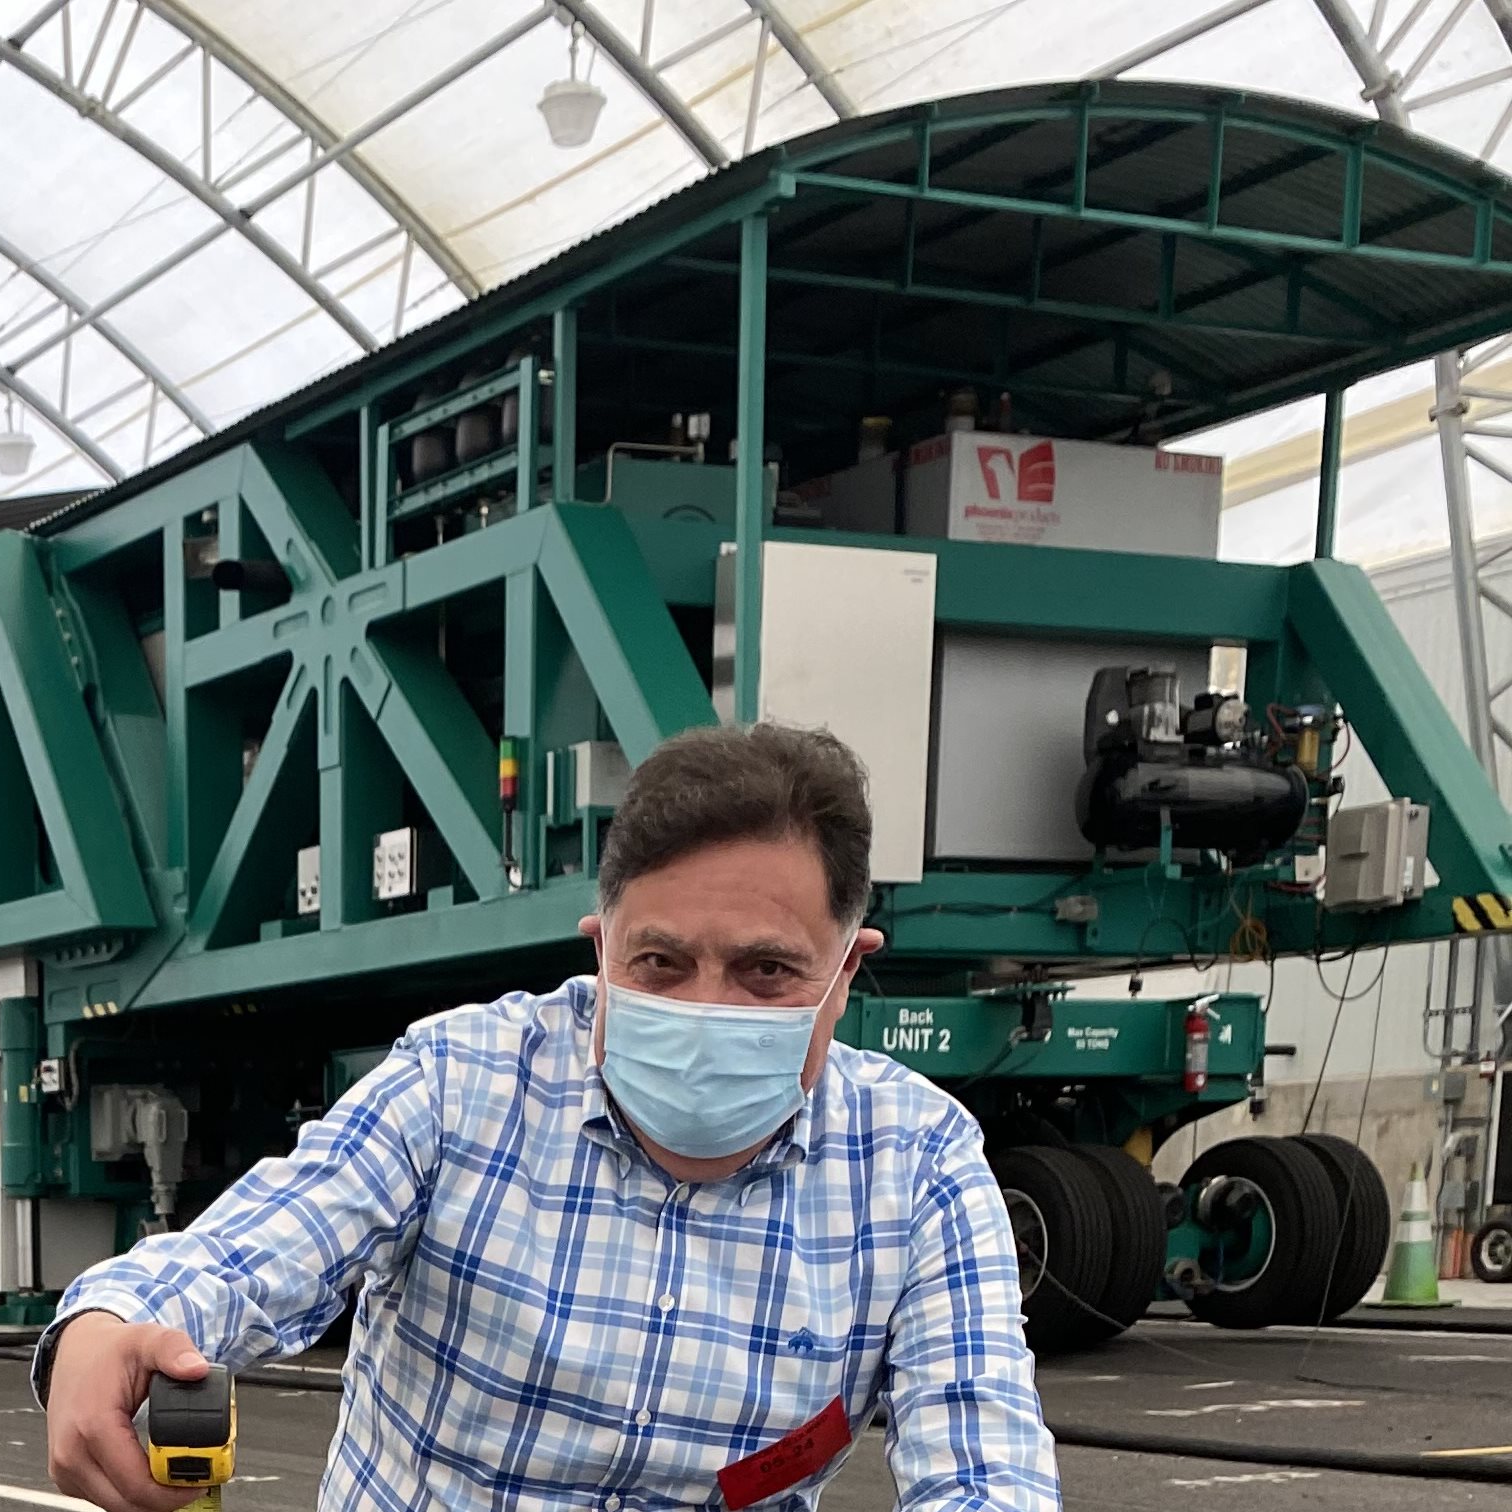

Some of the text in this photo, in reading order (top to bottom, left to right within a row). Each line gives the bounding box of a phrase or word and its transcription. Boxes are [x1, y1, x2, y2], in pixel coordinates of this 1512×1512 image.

[899, 1008, 934, 1026] Back
[883, 1027, 951, 1053] UNIT 2
